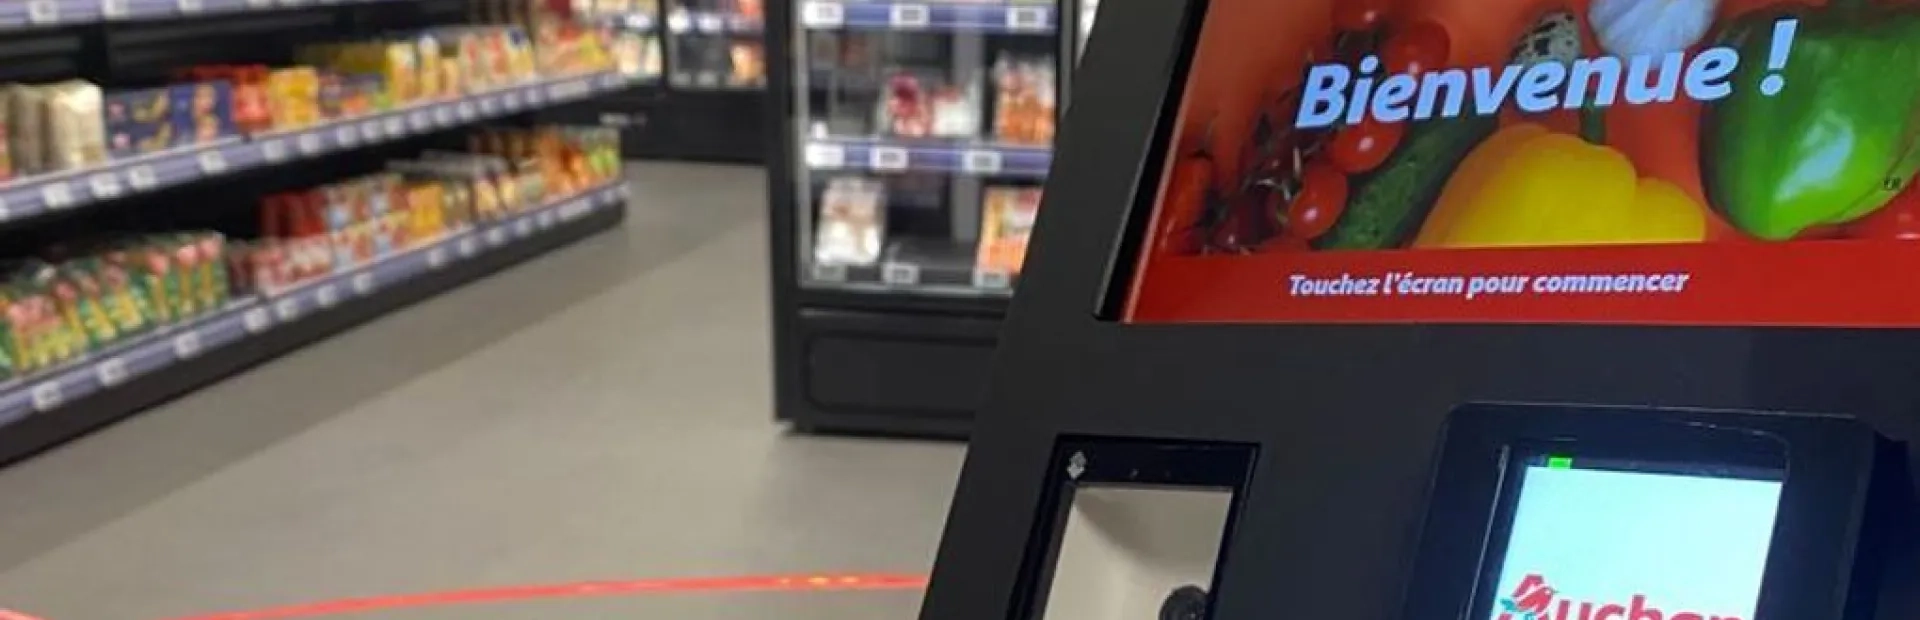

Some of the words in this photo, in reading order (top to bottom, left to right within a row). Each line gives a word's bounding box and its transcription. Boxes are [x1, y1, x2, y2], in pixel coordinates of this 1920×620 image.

[1295, 55, 1740, 129] Bienvenue
[1759, 18, 1798, 96] !
[1289, 273, 1379, 296] Touchez
[1382, 271, 1465, 294] l'écran
[1466, 275, 1530, 300] pour
[1532, 273, 1689, 293] commencer
